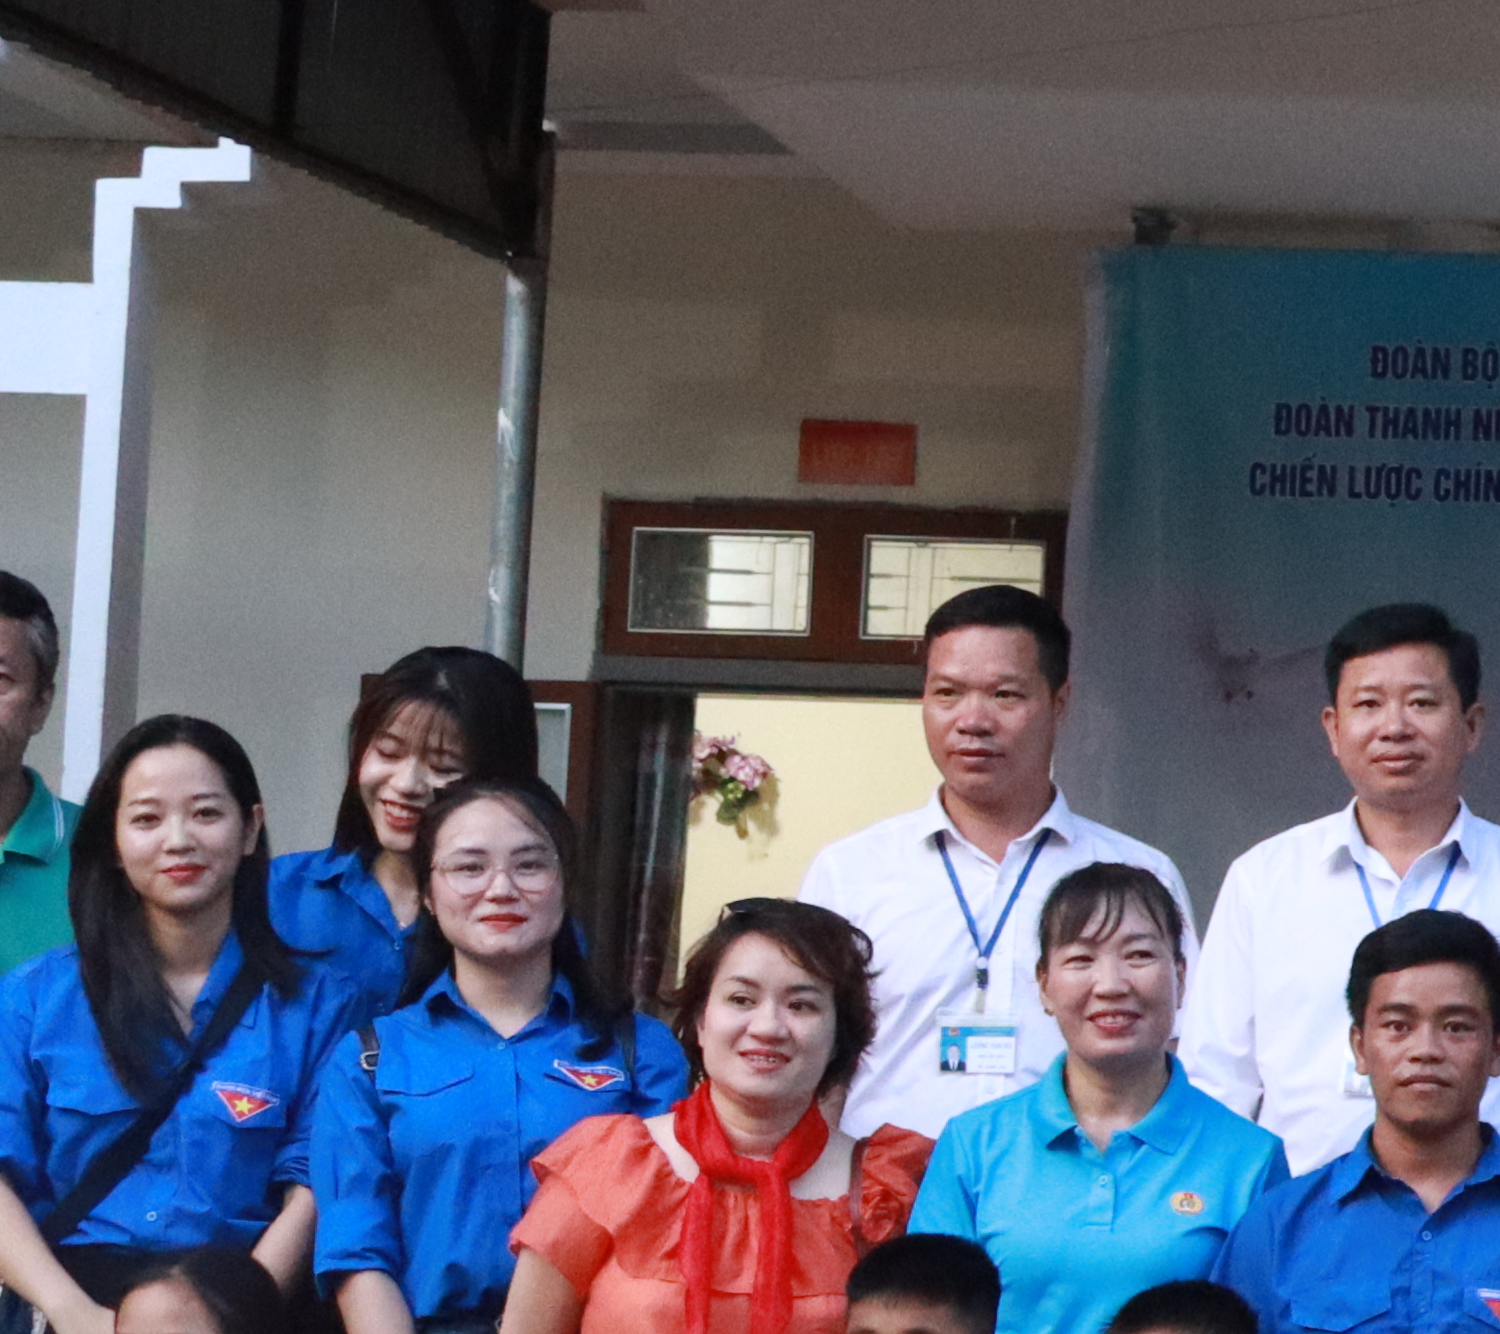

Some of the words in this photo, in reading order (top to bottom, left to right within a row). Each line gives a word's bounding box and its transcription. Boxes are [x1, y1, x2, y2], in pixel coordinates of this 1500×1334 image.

[1369, 340, 1452, 383] ĐOÀN
[1461, 340, 1500, 389] BỘ
[1272, 398, 1358, 440] ĐOÀN
[1365, 404, 1466, 444] THANH
[1247, 455, 1339, 501] CHIẾN
[1345, 462, 1423, 512] LƯỢC
